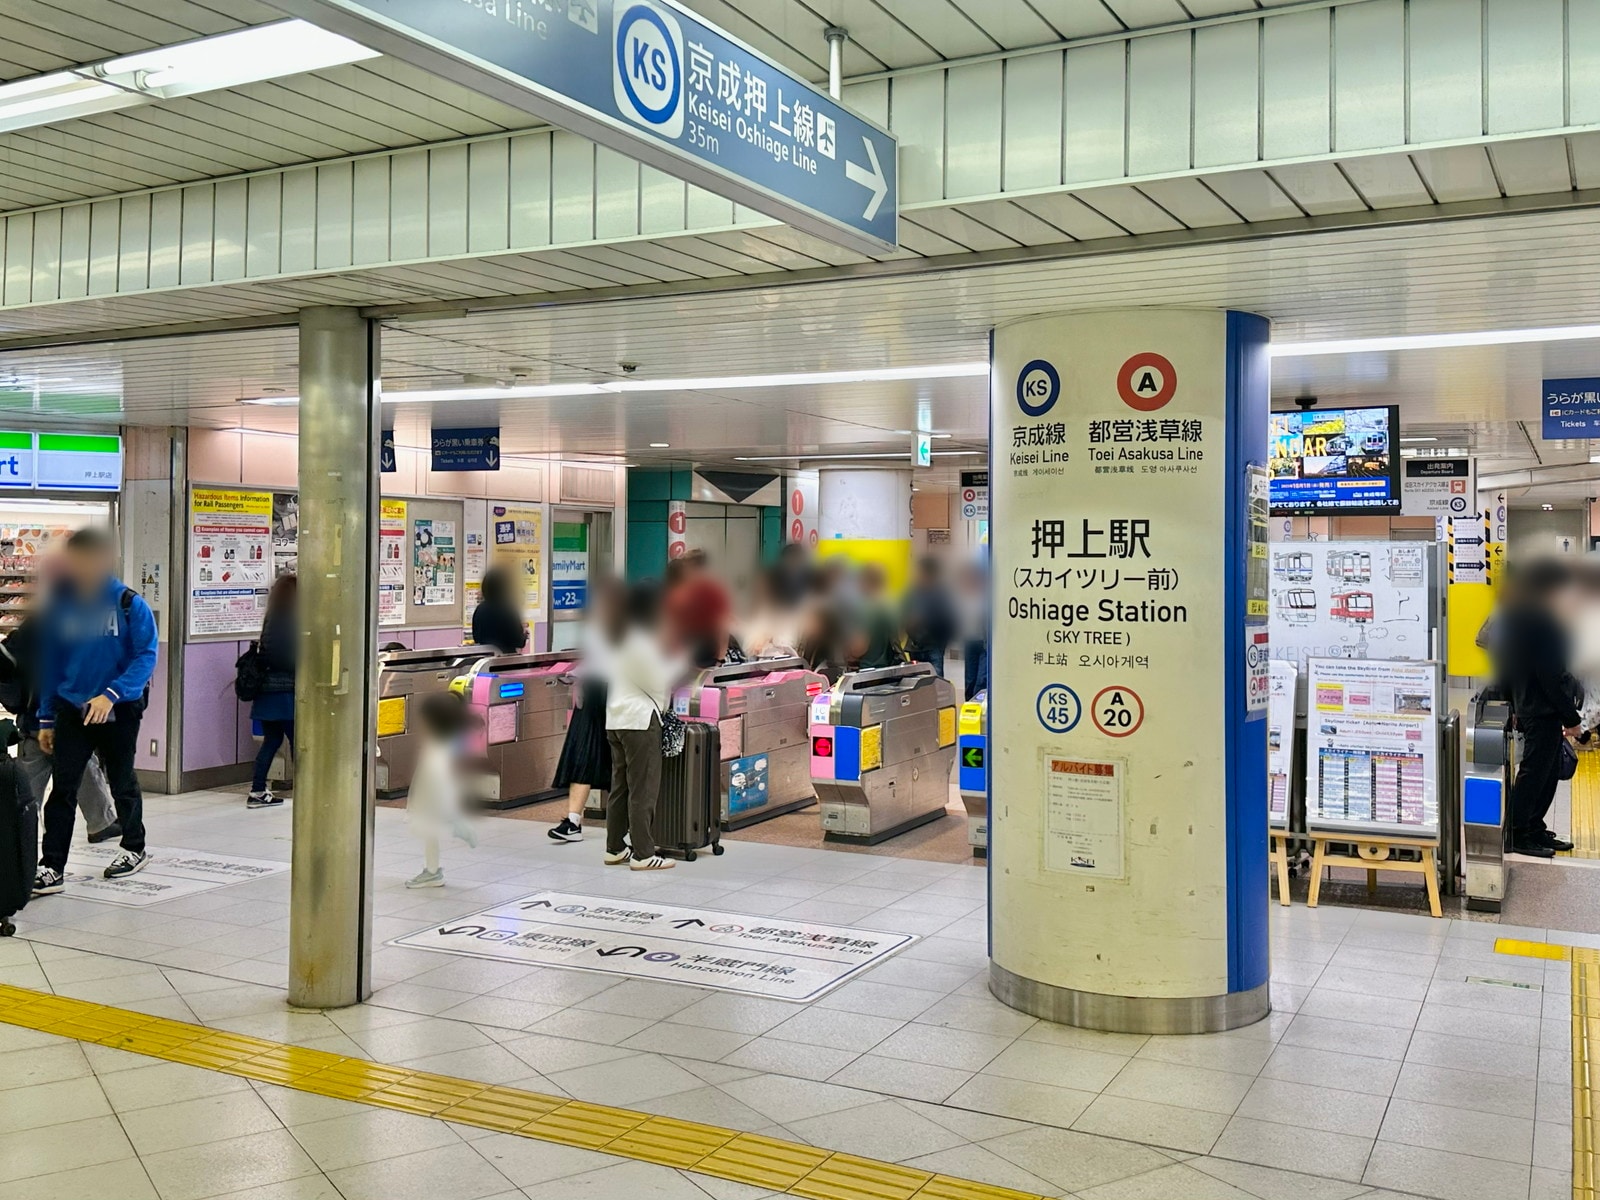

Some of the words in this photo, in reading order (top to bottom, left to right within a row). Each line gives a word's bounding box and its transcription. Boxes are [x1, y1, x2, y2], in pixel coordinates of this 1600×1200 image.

[506, 0, 547, 41] Line
[633, 37, 666, 91] KS
[688, 41, 815, 148] 京成押上線
[688, 91, 732, 133] Keisei
[736, 117, 789, 163] Oshiage
[792, 145, 817, 175] Line
[688, 120, 719, 155] 35m
[1026, 379, 1048, 398] KS
[1137, 372, 1157, 392] A
[1088, 419, 1203, 443] 都営浅草線
[1560, 420, 1586, 428] Tickets
[1012, 422, 1066, 448] 京成線
[1009, 450, 1039, 465] Keisei
[1042, 449, 1069, 463] Line
[1087, 447, 1114, 461] Toei
[1118, 446, 1174, 460] Asakusa
[1177, 446, 1204, 460] Line
[194, 492, 223, 501] Hazardous
[240, 495, 270, 503] Information
[194, 499, 202, 507] for
[203, 500, 214, 508] Rail
[215, 501, 244, 509] Passengers
[1031, 519, 1151, 559] 押上駅
[1014, 567, 1179, 591] (スカイツリー前)
[565, 591, 577, 606] 23
[1008, 597, 1090, 627] Oshiage
[1098, 599, 1187, 623] Station
[1033, 652, 1068, 667] 押上站
[1078, 654, 1149, 669] 오시아게역
[1048, 692, 1068, 706] KS
[1110, 692, 1124, 706] A
[1046, 707, 1069, 725] 45
[1103, 709, 1132, 728] 20
[575, 912, 617, 922] Keisei
[620, 916, 653, 925] Line
[589, 907, 663, 920] 京成線
[504, 939, 538, 950] Tobu
[539, 943, 572, 953] Line
[518, 932, 597, 948] 東武線
[737, 932, 767, 942] Toei
[769, 936, 836, 951] Asakusa
[838, 945, 874, 957] Line
[750, 926, 879, 949] 都営浅草線
[670, 961, 756, 980] Hanzomon
[759, 974, 795, 985] Line
[687, 953, 797, 976] 半蔵門線
